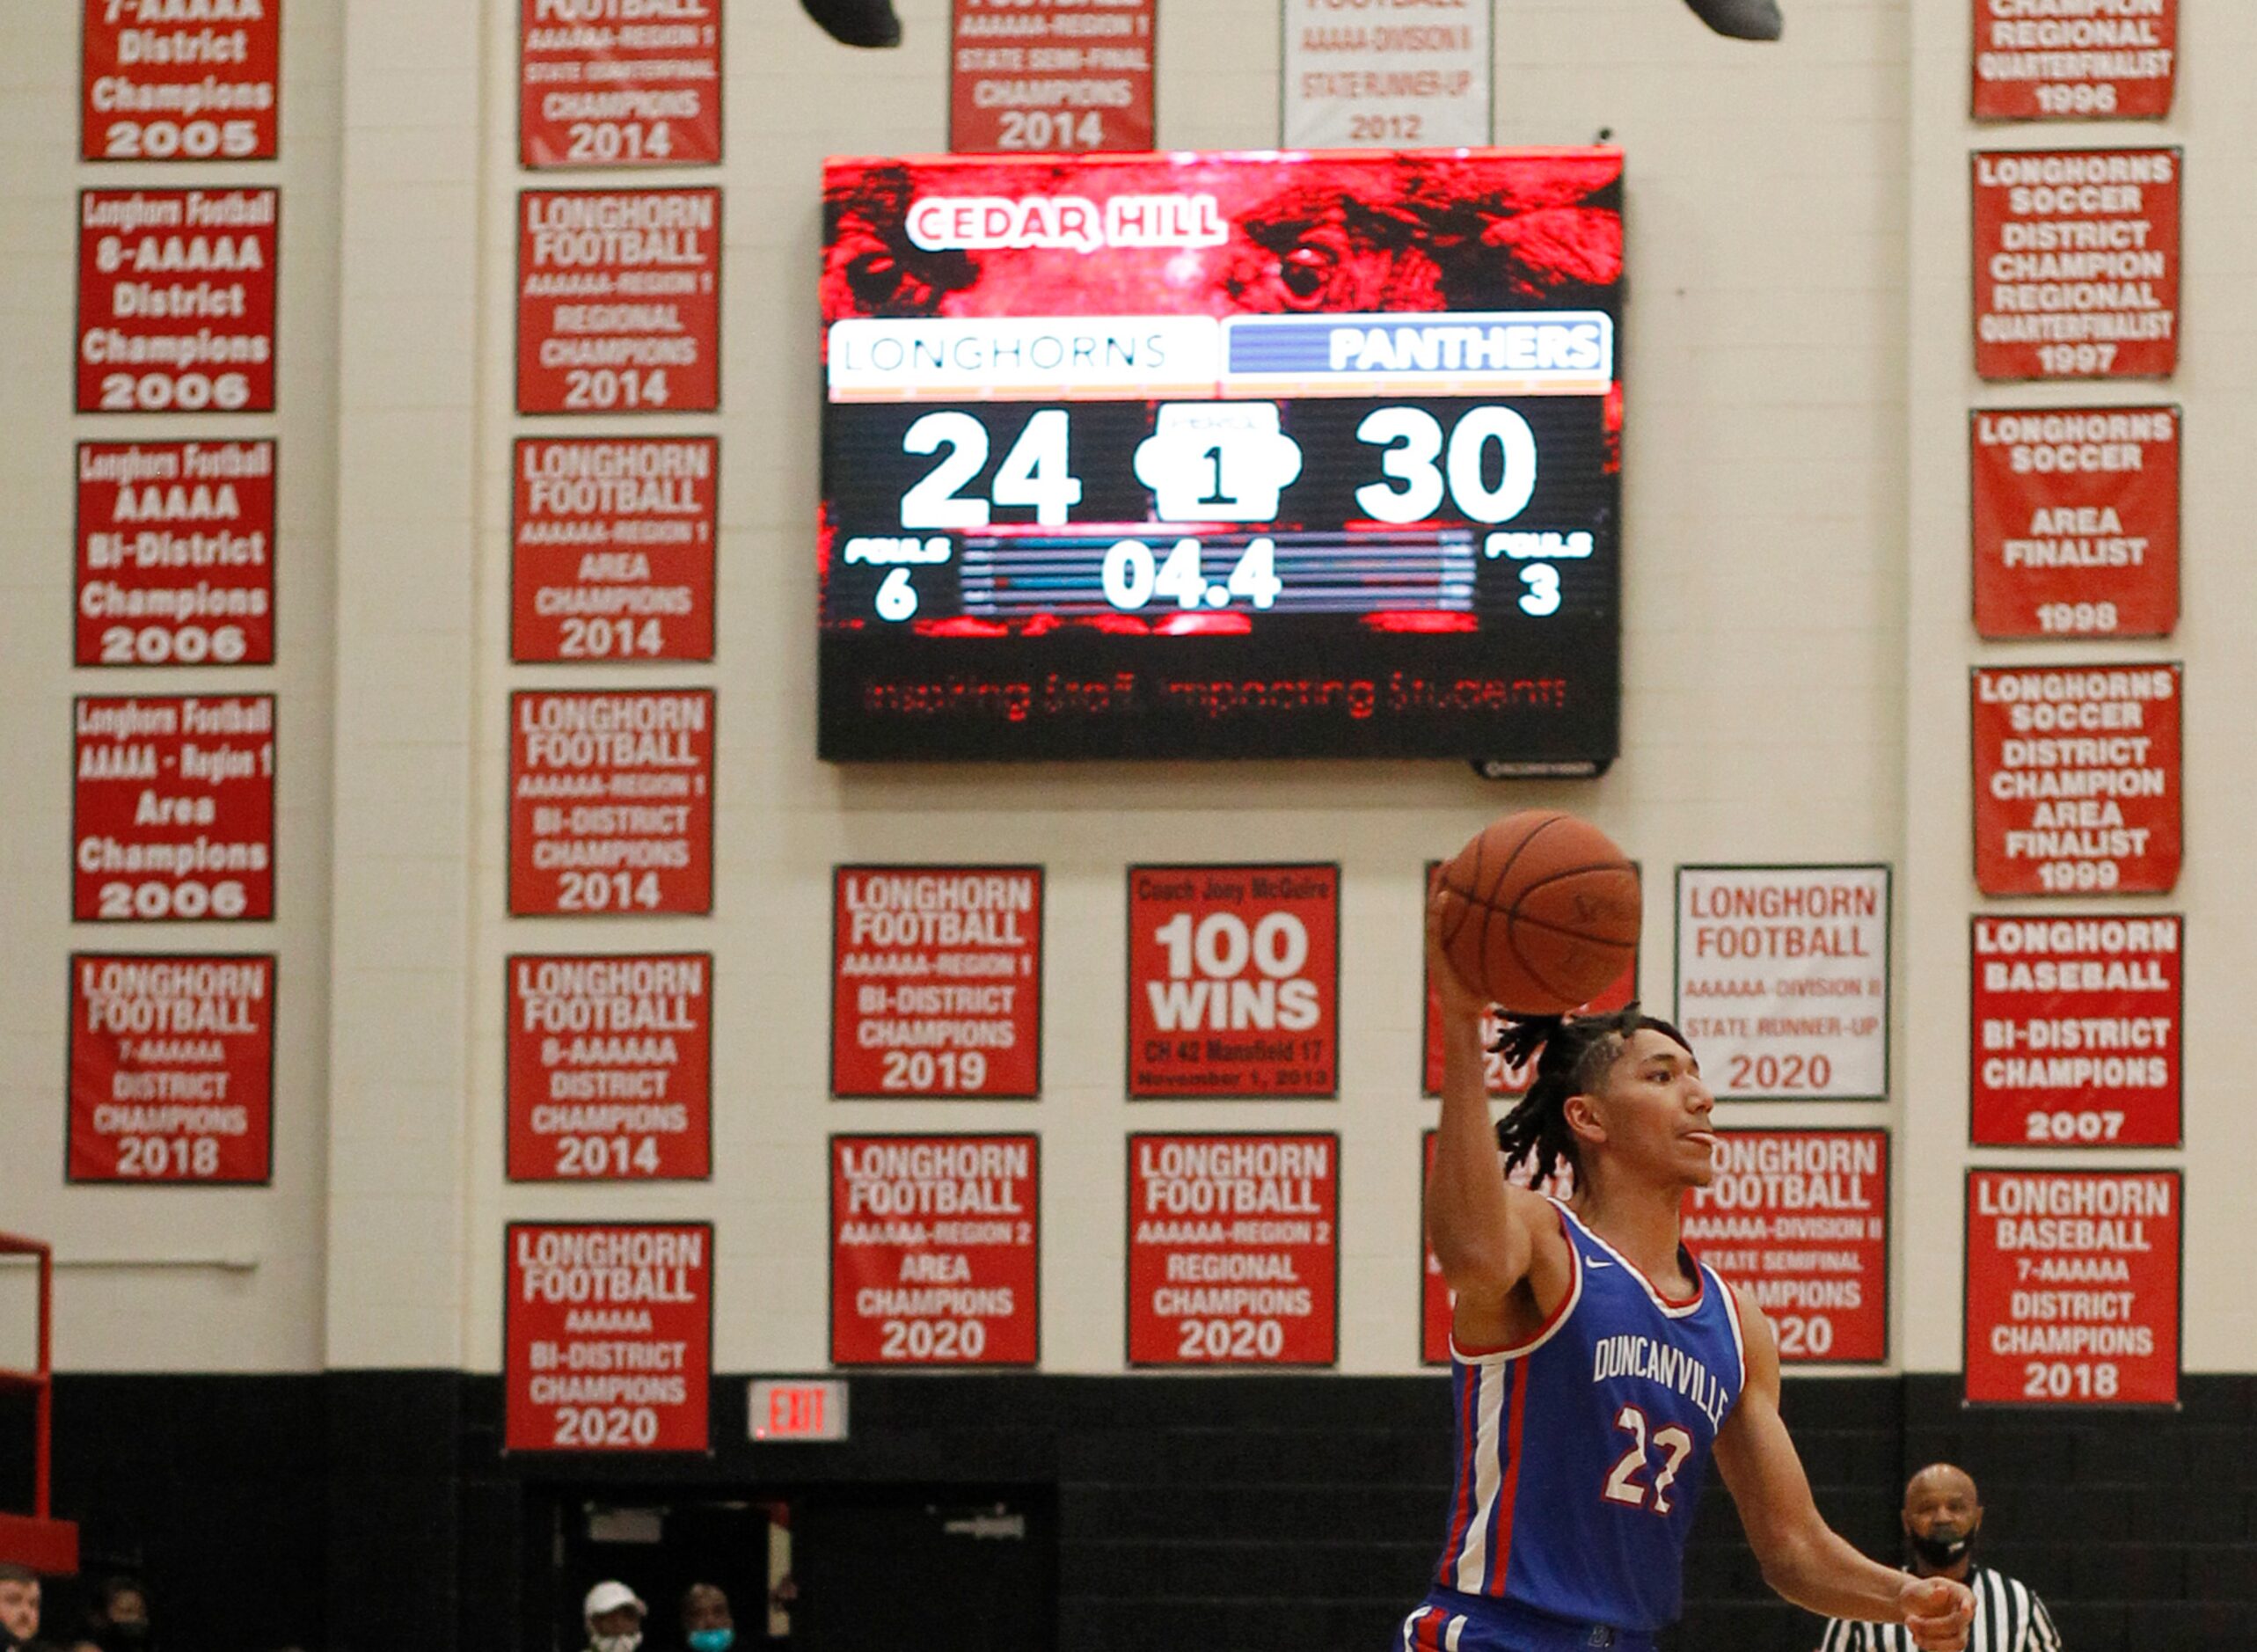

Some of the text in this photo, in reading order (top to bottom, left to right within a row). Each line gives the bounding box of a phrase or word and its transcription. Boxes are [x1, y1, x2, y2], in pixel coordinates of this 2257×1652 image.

[117, 26, 248, 64] District
[1991, 20, 2158, 47] REGIONAL
[91, 76, 274, 117] Champions
[2035, 84, 2117, 113] 1996
[106, 121, 258, 157] 2005
[567, 122, 672, 160] 2014
[998, 110, 1104, 149] 2014
[1349, 113, 1422, 140] 2012
[1978, 157, 2173, 186] LONGHORNS
[527, 196, 712, 231] LONGHORN
[2009, 186, 2143, 214] SOCCER
[907, 194, 1228, 252] CEDAR HILL
[2001, 220, 2151, 250] DISTRICT
[533, 230, 707, 267] FOOTBALL
[1990, 252, 2165, 281] CHAMPION
[112, 282, 245, 318] District
[1993, 282, 2161, 311] REGIONAL
[552, 304, 684, 333] REGIONAL
[82, 328, 270, 369] Champions
[539, 338, 698, 368] CHAMPIONS
[844, 335, 1165, 371] LONGHORNS
[1329, 325, 1600, 371] PANTHERS
[2036, 344, 2116, 372] 1997
[99, 372, 250, 409] 2006
[565, 369, 670, 408] 2014
[1979, 415, 2173, 444] LONGHORNS
[523, 444, 710, 479] LONGHORN
[901, 408, 1082, 529] 24
[1198, 447, 1238, 503] 1
[1355, 405, 1537, 523] 30
[2010, 444, 2143, 472] SOCCER
[529, 479, 704, 515] FOOTBALL
[2030, 507, 2122, 536] AREA
[578, 552, 651, 582] AREA
[2002, 538, 2149, 567] FINALIST
[1102, 538, 1282, 609] 04.4
[1517, 563, 1560, 616] 3
[80, 581, 267, 623] Champions
[534, 587, 694, 617] CHAMPIONS
[875, 568, 917, 621] 6
[100, 625, 246, 663] 2006
[559, 618, 665, 657] 2014
[1979, 672, 2173, 702] LONGHORNS
[521, 698, 705, 732] LONGHORN
[2011, 702, 2143, 731] SOCCER
[525, 731, 698, 767] FOOTBALL
[2002, 737, 2151, 767] DISTRICT
[1990, 770, 2166, 800] CHAMPION
[135, 790, 216, 827] Area
[2033, 800, 2123, 828] AREA
[78, 837, 267, 877] Champions
[532, 840, 690, 870] CHAMPIONS
[2005, 830, 2151, 859] FINALIST
[557, 872, 661, 910] 2014
[2038, 860, 2120, 890] 1999
[99, 881, 247, 918] 2006
[846, 876, 1033, 912] LONGHORN
[1691, 886, 1877, 917] LONGHORN
[851, 910, 1025, 946] FOOTBALL
[1155, 911, 1309, 979] 100
[1696, 926, 1870, 957] FOOTBALL
[1976, 923, 2177, 953] LONGHORN
[81, 964, 265, 1000] LONGHORN
[518, 962, 703, 998] LONGHORN
[1984, 961, 2170, 991] BASEBALL
[87, 998, 257, 1033] FOOTBALL
[523, 995, 697, 1032] FOOTBALL
[858, 985, 1016, 1014] BI-DISTRICT
[1146, 979, 1320, 1031] WINS
[858, 1020, 1016, 1048] CHAMPIONS
[1686, 1017, 1749, 1037] STATE
[1983, 1019, 2170, 1049] BI-DISTRICT
[112, 1071, 230, 1101] DISTRICT
[551, 1071, 669, 1100] DISTRICT
[881, 1051, 987, 1089] 2019
[1729, 1055, 1831, 1089] 2020
[1983, 1059, 2167, 1088] CHAMPIONS
[93, 1105, 248, 1136] CHAMPIONS
[531, 1104, 689, 1134] CHAMPIONS
[2027, 1112, 2126, 1139] 2007
[116, 1137, 219, 1176] 2018
[556, 1137, 661, 1174] 2014
[841, 1145, 1028, 1179] LONGHORN
[1140, 1144, 1327, 1179] LONGHORN
[850, 1179, 1021, 1214] FOOTBALL
[1146, 1179, 1320, 1214] FOOTBALL
[1978, 1180, 2170, 1215] LONGHORN
[517, 1232, 703, 1268] LONGHORN
[1996, 1219, 2151, 1251] BASEBALL
[522, 1267, 697, 1303] FOOTBALL
[899, 1254, 971, 1283] AREA
[1166, 1254, 1298, 1283] REGIONAL
[856, 1288, 1014, 1317] CHAMPIONS
[1153, 1288, 1312, 1316] CHAMPIONS
[2011, 1292, 2136, 1319] DISTRICT
[530, 1341, 687, 1371] BI-DISTRICT
[880, 1319, 986, 1358] 2020
[1178, 1319, 1284, 1358] 2020
[1991, 1327, 2154, 1356] CHAMPIONS
[530, 1375, 687, 1405] CHAMPIONS
[1593, 1334, 1729, 1436] DUNCANVILLE
[2023, 1363, 2119, 1397] 2018
[554, 1407, 658, 1446] 2020
[770, 1389, 825, 1435] EXIT
[1601, 1402, 1694, 1517] 22
